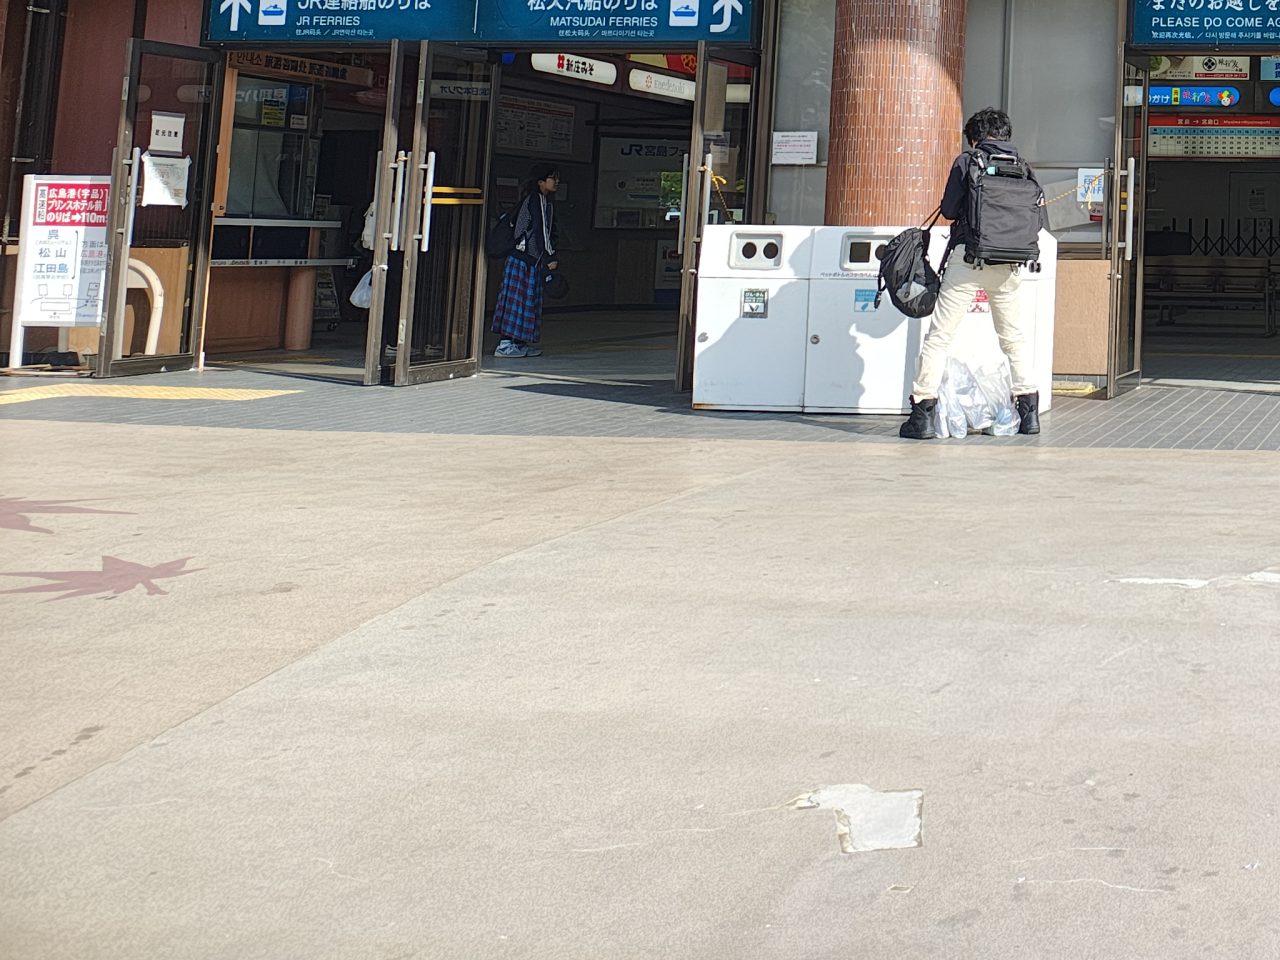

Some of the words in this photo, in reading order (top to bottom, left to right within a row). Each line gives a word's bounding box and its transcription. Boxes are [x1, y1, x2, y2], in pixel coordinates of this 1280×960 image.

[296, 16, 310, 26] JR
[313, 16, 361, 26] FERRIES
[550, 16, 606, 27] MATSUDAI
[609, 16, 658, 27] FERRIES
[1152, 16, 1200, 28] PLEASE
[1203, 16, 1222, 28] DO
[1226, 16, 1263, 28] COME
[566, 58, 595, 76] 新庄みそ
[48, 229, 59, 239] 呉
[33, 263, 69, 274] 江田島
